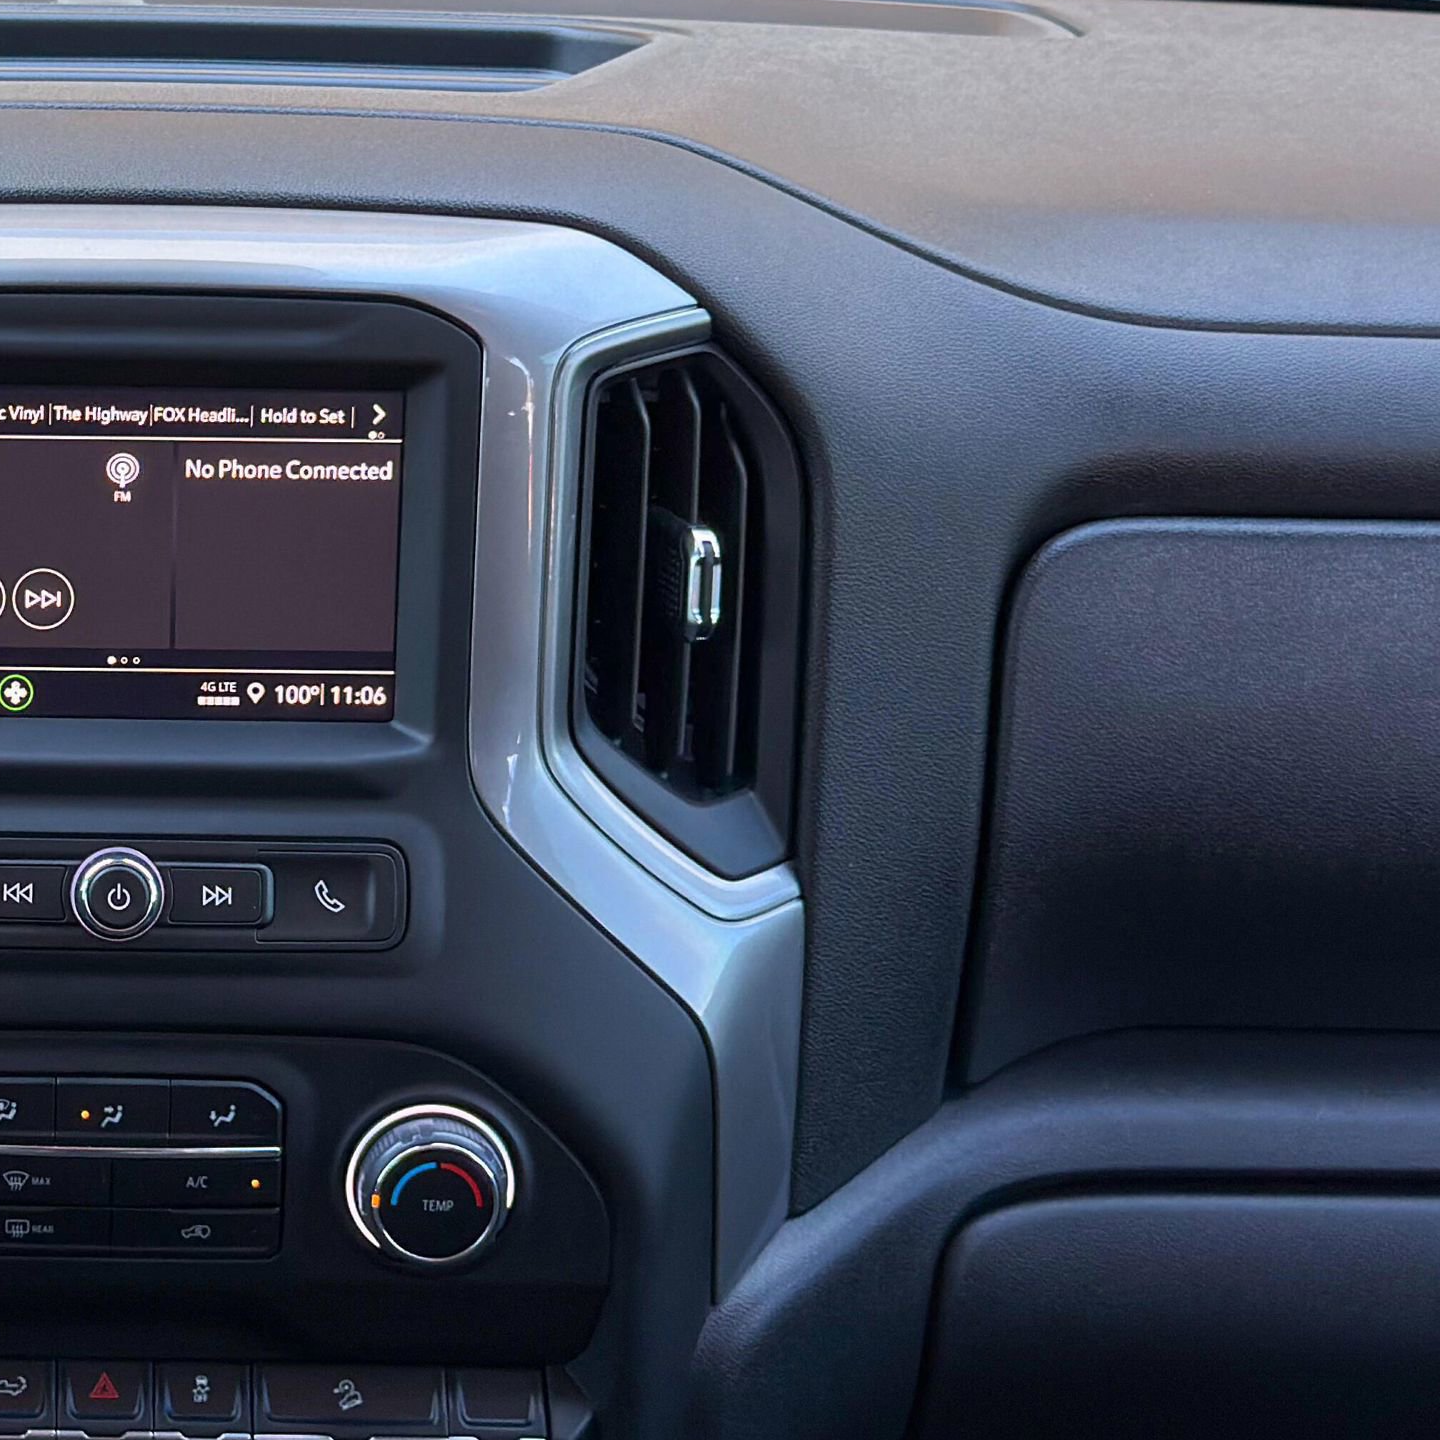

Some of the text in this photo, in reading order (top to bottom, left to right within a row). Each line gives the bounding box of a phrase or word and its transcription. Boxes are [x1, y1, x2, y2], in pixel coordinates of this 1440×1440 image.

[8, 405, 45, 425] Vinyl
[53, 405, 148, 426] The Highway
[153, 406, 250, 425] FOX Headli...
[260, 408, 345, 426] Hold to Set
[185, 461, 393, 482] No Phone Connected
[113, 490, 132, 503] FM
[199, 680, 237, 693] 4G LTE
[330, 685, 387, 705] 11:06
[31, 1177, 52, 1186] MAX
[185, 1176, 209, 1189] A/C
[422, 1199, 455, 1212] TEMP
